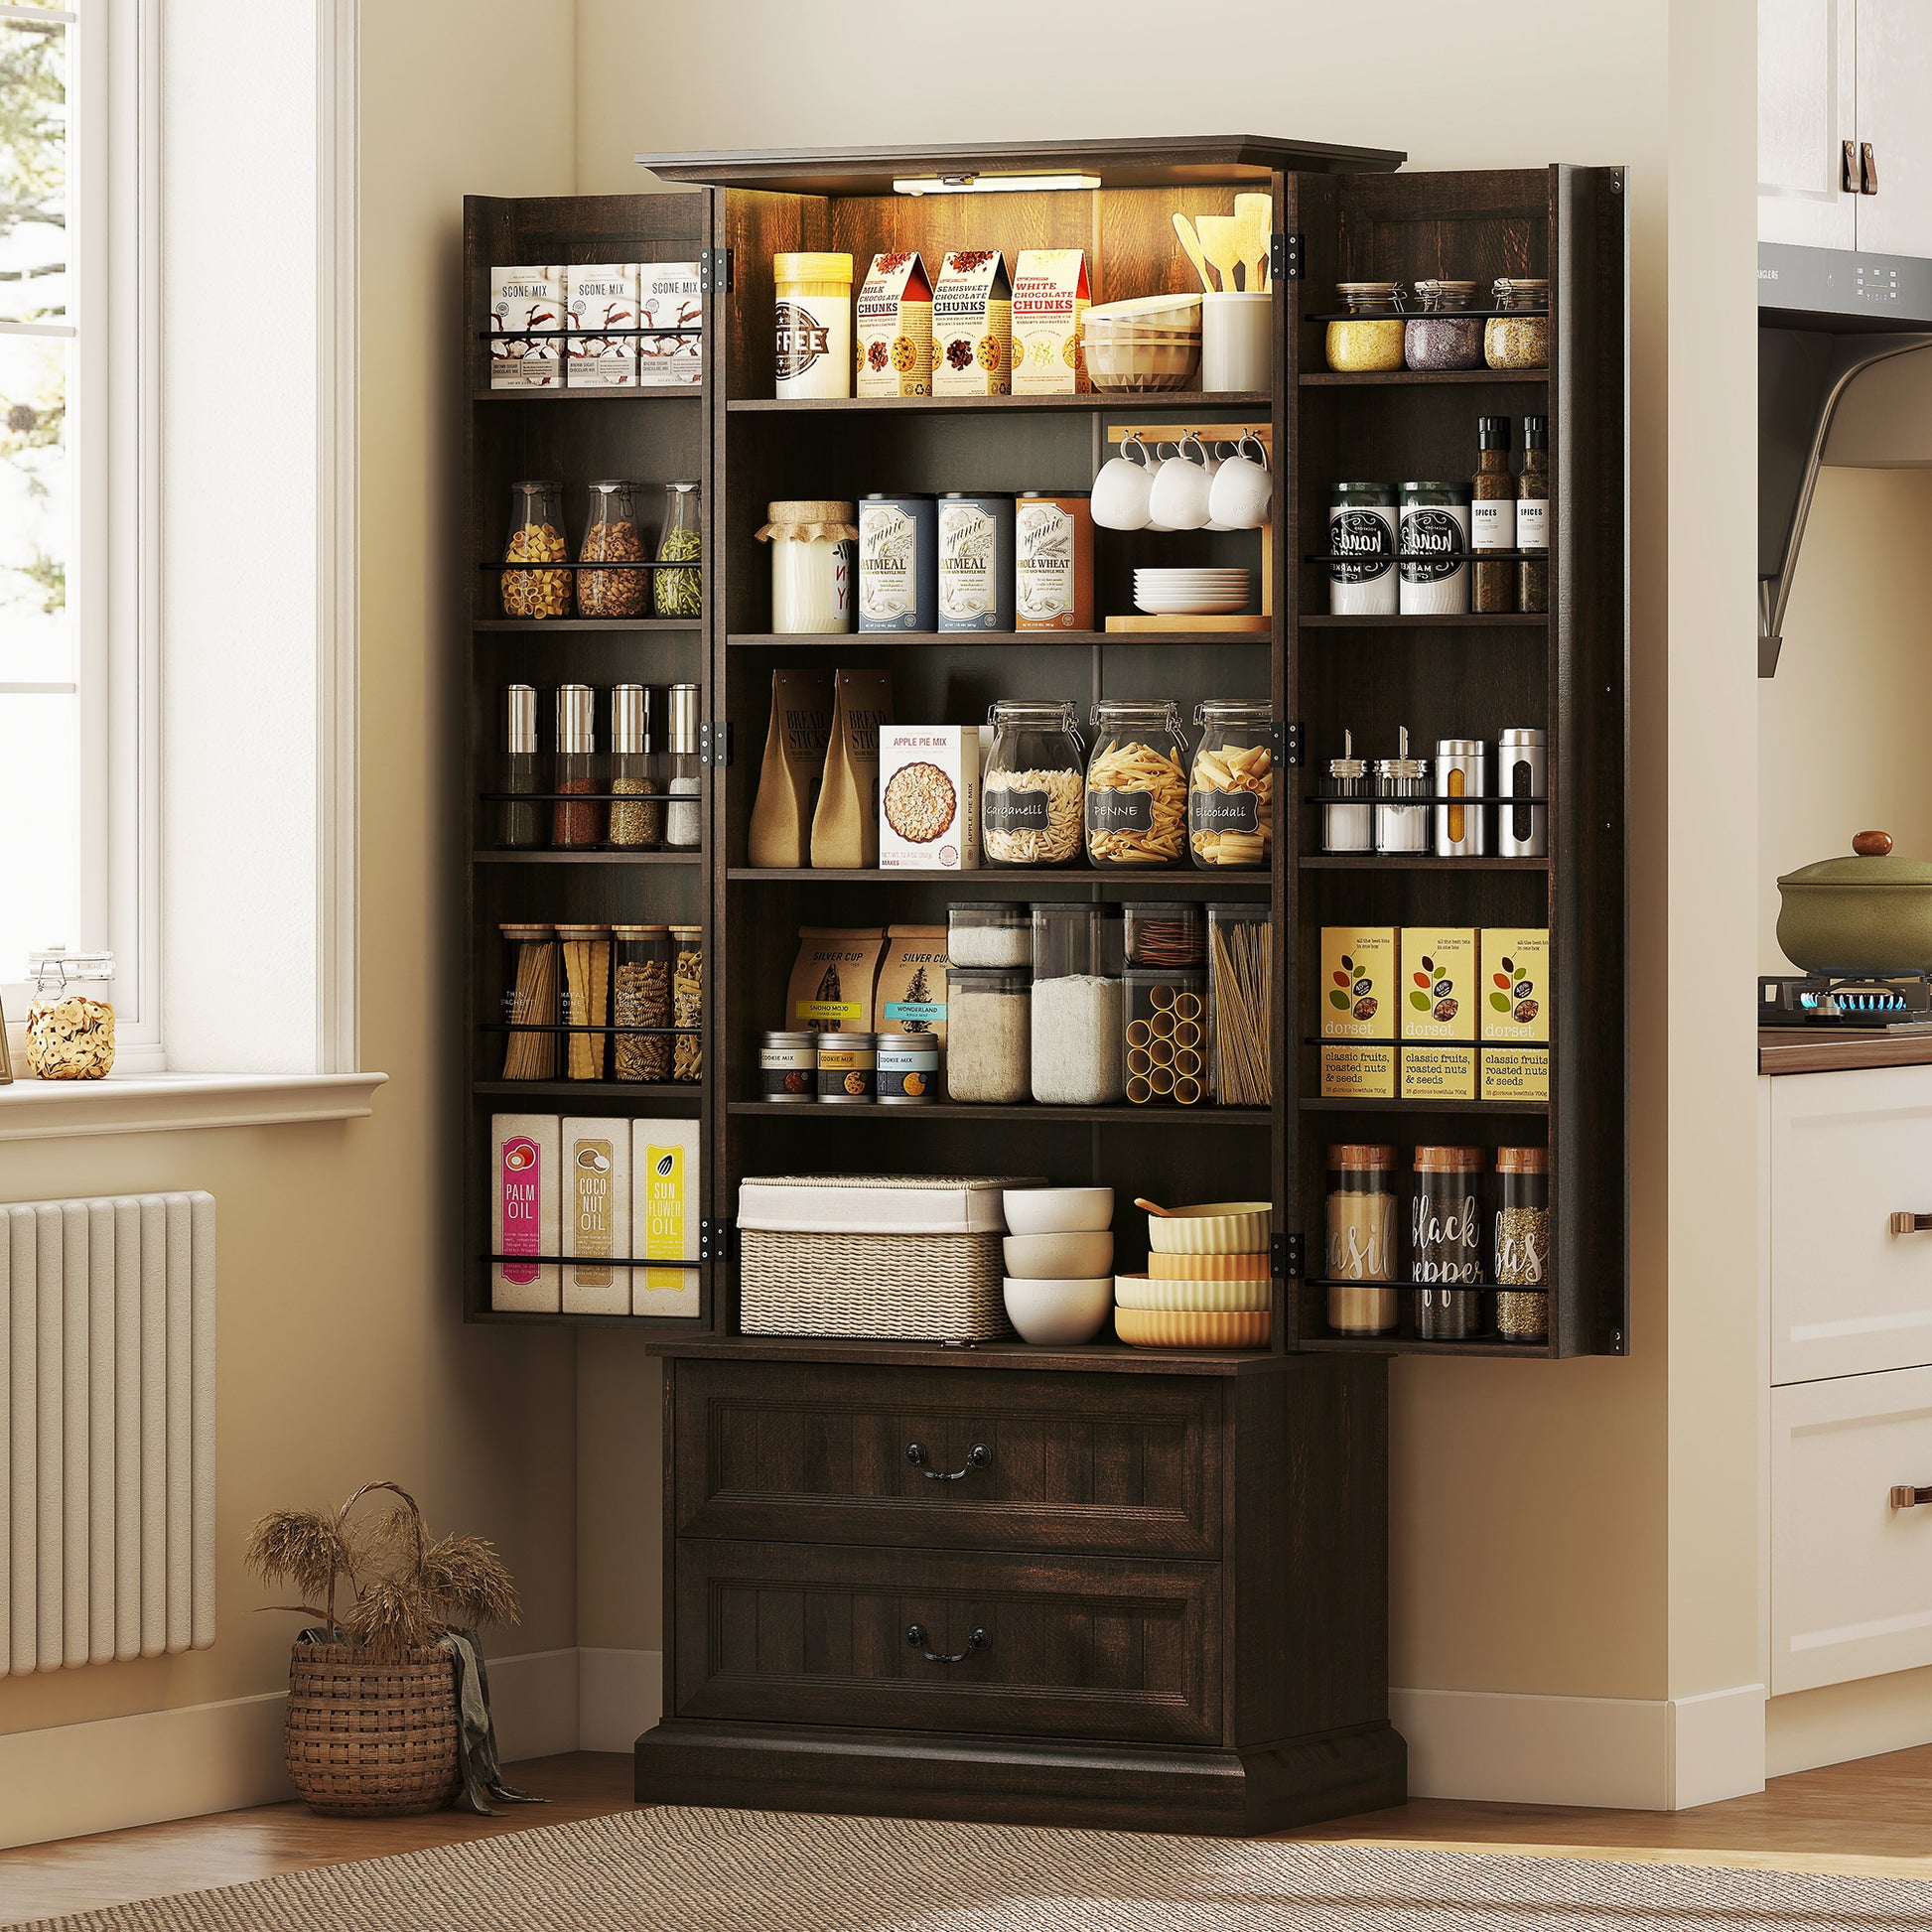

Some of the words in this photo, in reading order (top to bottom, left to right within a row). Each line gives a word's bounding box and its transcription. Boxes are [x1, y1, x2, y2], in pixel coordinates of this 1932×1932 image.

[502, 285, 528, 298] SCONE
[532, 285, 547, 297] MIX
[579, 283, 606, 296] SCONE
[609, 283, 623, 295] MIX
[652, 282, 679, 295] SCONE
[683, 281, 698, 293] MIX
[936, 284, 989, 293] SEMISWEET
[934, 292, 987, 301] CHOCOLATE
[858, 302, 897, 314] CHUNKS
[934, 301, 986, 312] CHUNKS
[1014, 300, 1073, 310] CHUNKS
[861, 558, 906, 571] OATMEAL
[940, 557, 987, 570] OATMEAL
[1037, 559, 1070, 568] WHEAT
[786, 710, 824, 729] BREAD
[849, 710, 887, 729] BREAD
[852, 730, 879, 749] STIC
[1094, 805, 1138, 816] PENNE
[813, 952, 843, 961] SILVER
[844, 952, 864, 961] CUP
[901, 953, 931, 962] SILVER
[1325, 1021, 1374, 1035] dorset
[1405, 1022, 1454, 1036] dorset
[1485, 1023, 1535, 1037] dorset
[1325, 1052, 1358, 1061] classic
[1361, 1052, 1390, 1063] fruits,
[1406, 1053, 1439, 1063] classic
[1441, 1053, 1470, 1064] fruits,
[1485, 1055, 1519, 1064] classic
[1325, 1063, 1361, 1072] roasted
[1445, 1065, 1467, 1074] nuts
[1485, 1066, 1522, 1075] roasted
[1525, 1066, 1548, 1075] nuts
[1325, 1073, 1334, 1082] &
[1336, 1074, 1363, 1083] seeds
[1406, 1074, 1415, 1084] &
[1417, 1075, 1444, 1084] seeds
[1485, 1076, 1494, 1085] &
[1496, 1077, 1523, 1086] seeds
[506, 1183, 535, 1201] PALM
[579, 1177, 606, 1195] COCO
[654, 1182, 675, 1199] SUN
[508, 1201, 533, 1219] OIL
[583, 1195, 604, 1212] NUT
[648, 1200, 681, 1217] FLOWER
[581, 1213, 606, 1231] OIL
[652, 1217, 678, 1236] OIL
[1494, 1210, 1549, 1283] bas
